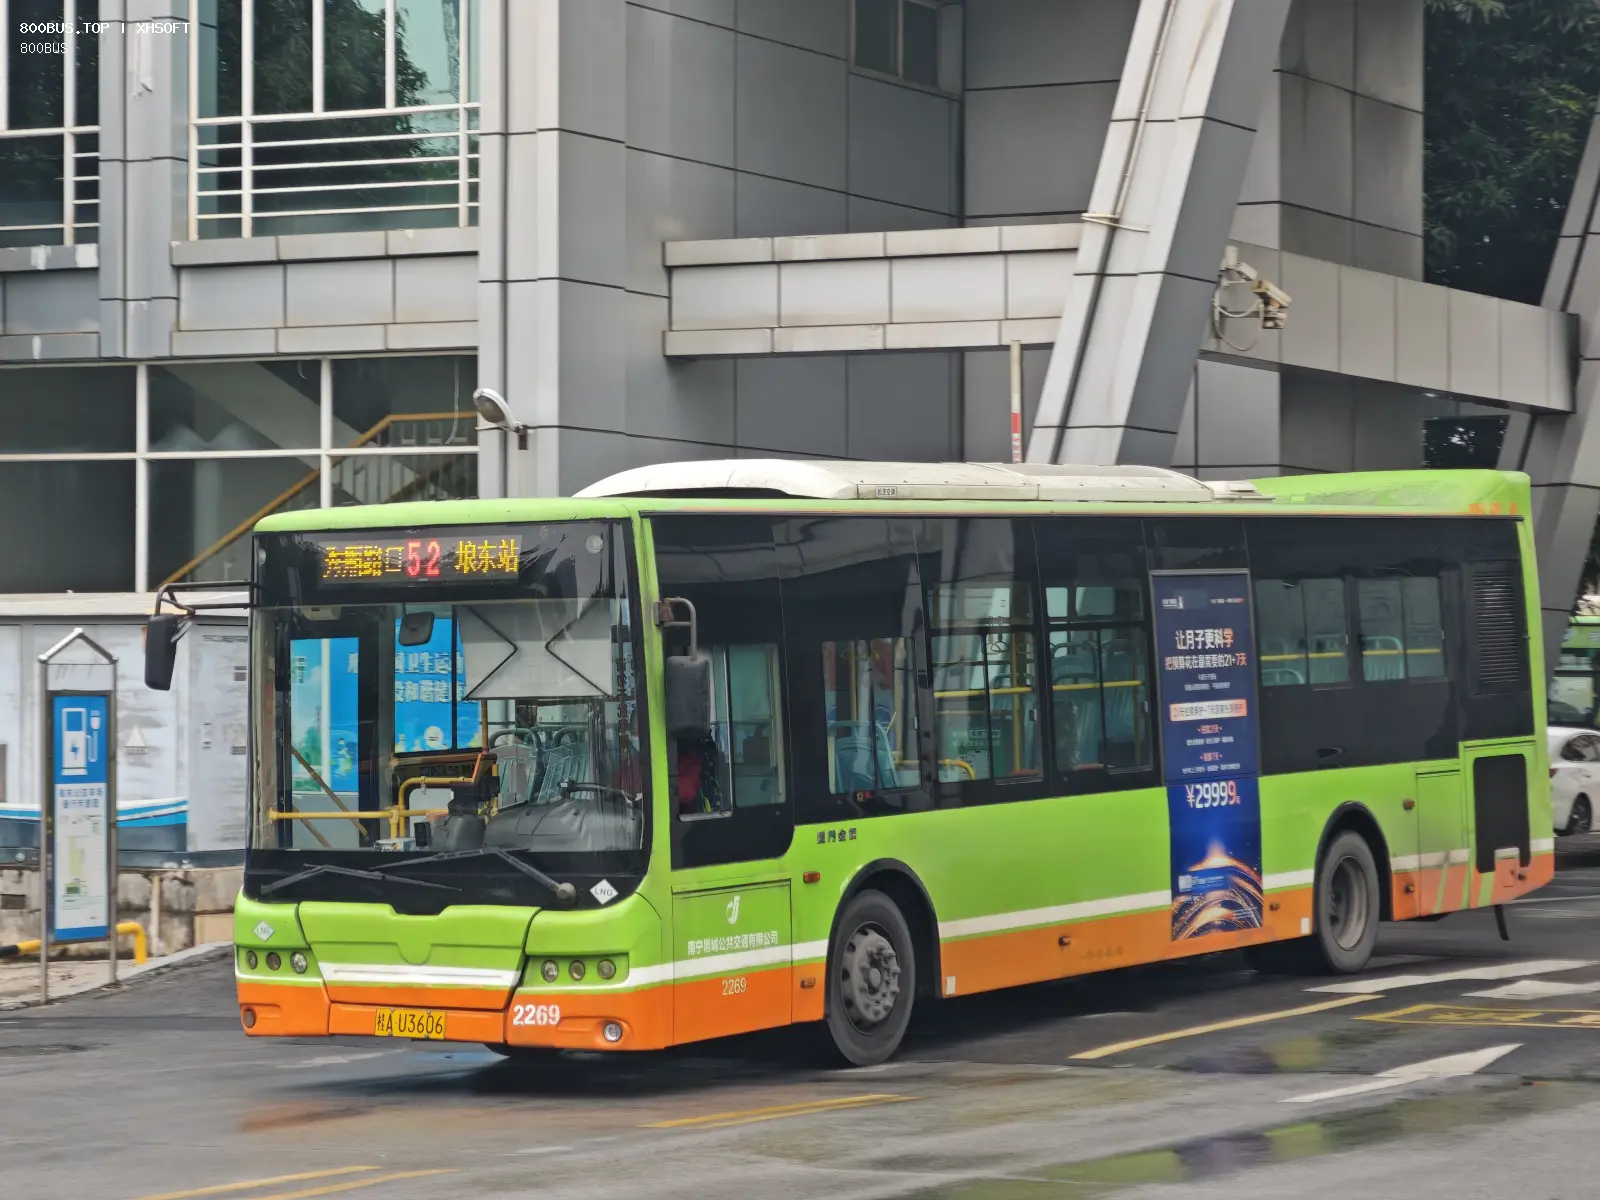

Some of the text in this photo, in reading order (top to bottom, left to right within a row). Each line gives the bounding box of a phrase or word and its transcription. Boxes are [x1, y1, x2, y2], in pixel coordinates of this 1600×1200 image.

[407, 538, 441, 577] 52
[455, 538, 520, 574] 埌东站
[1174, 628, 1234, 650] 让月子更科学
[594, 887, 613, 897] LNG
[722, 977, 747, 996] 2269
[512, 1003, 561, 1026] 2269
